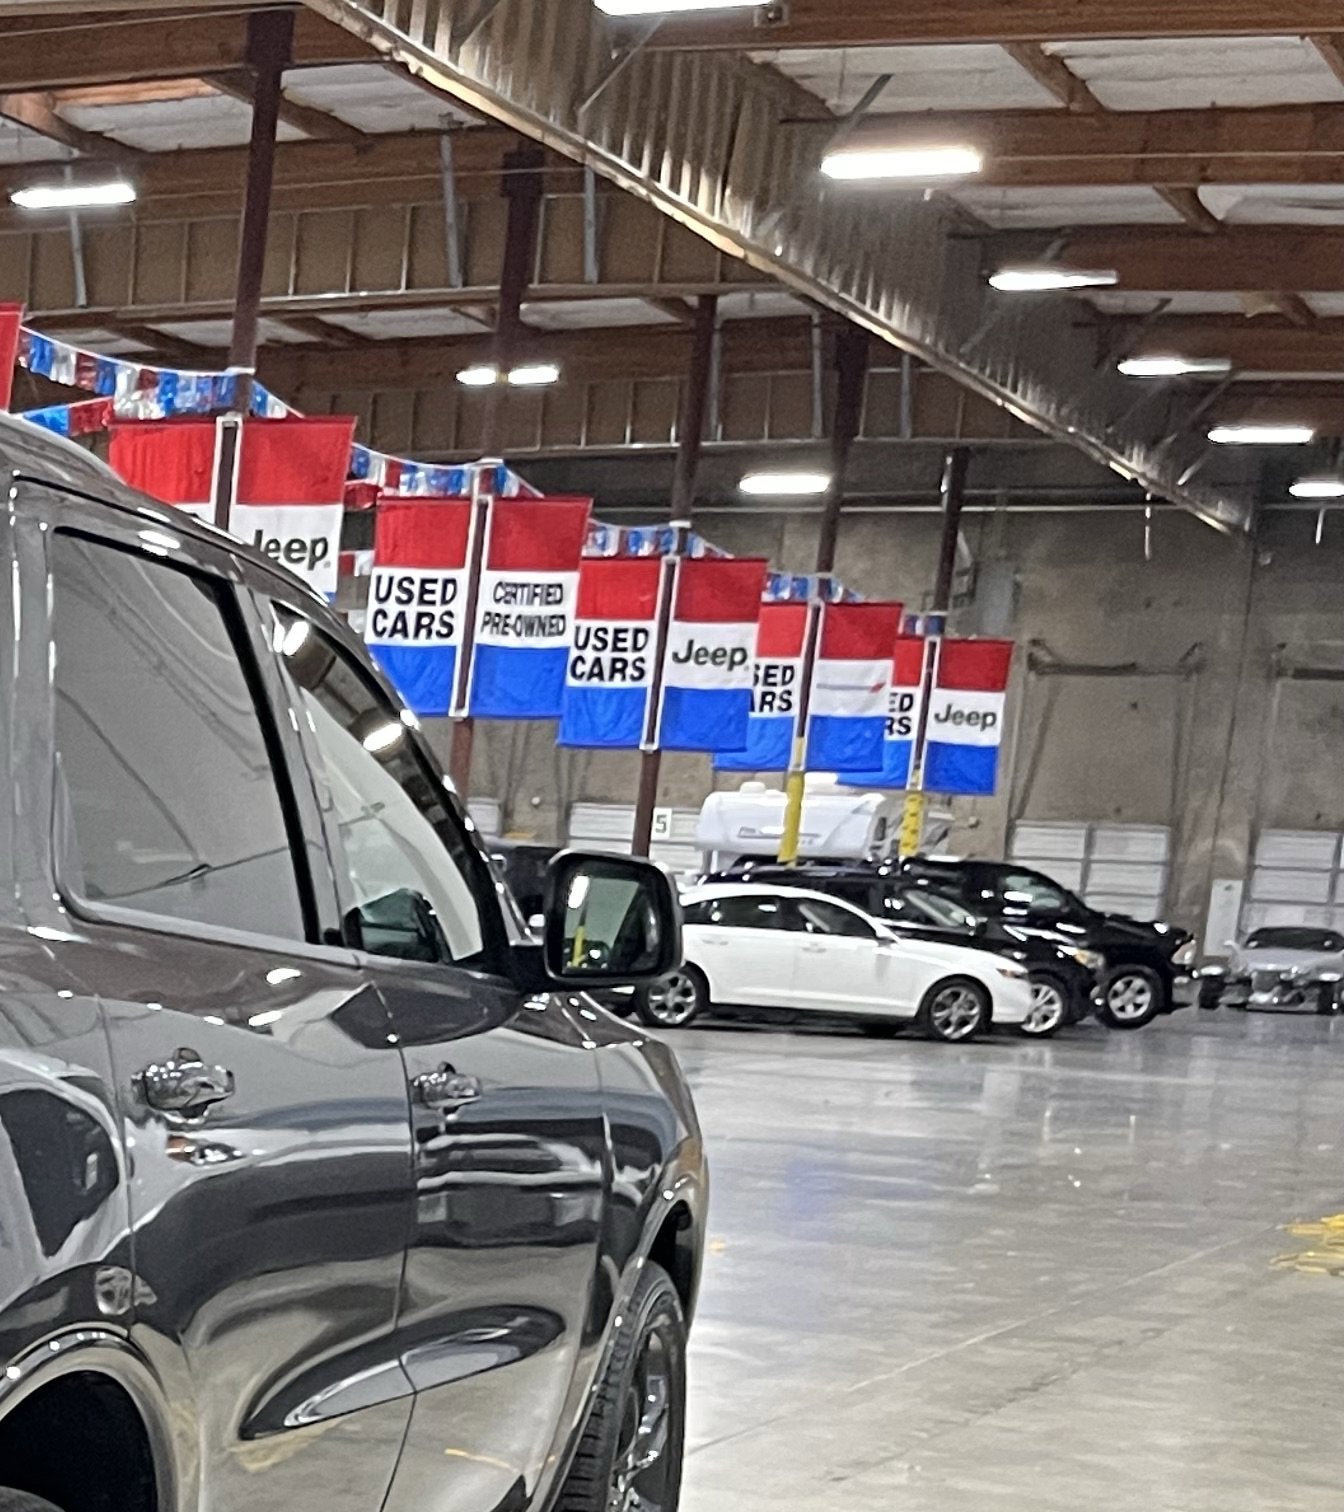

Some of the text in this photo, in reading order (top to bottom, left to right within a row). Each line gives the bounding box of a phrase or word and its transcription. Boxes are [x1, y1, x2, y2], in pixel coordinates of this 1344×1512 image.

[374, 574, 458, 607] USED
[372, 608, 455, 640] CARS
[574, 625, 650, 653] USED
[569, 655, 647, 683] CARS
[671, 639, 748, 672] Jeep
[753, 664, 795, 688] SED
[759, 690, 793, 713] RS
[934, 703, 998, 732] Jeep
